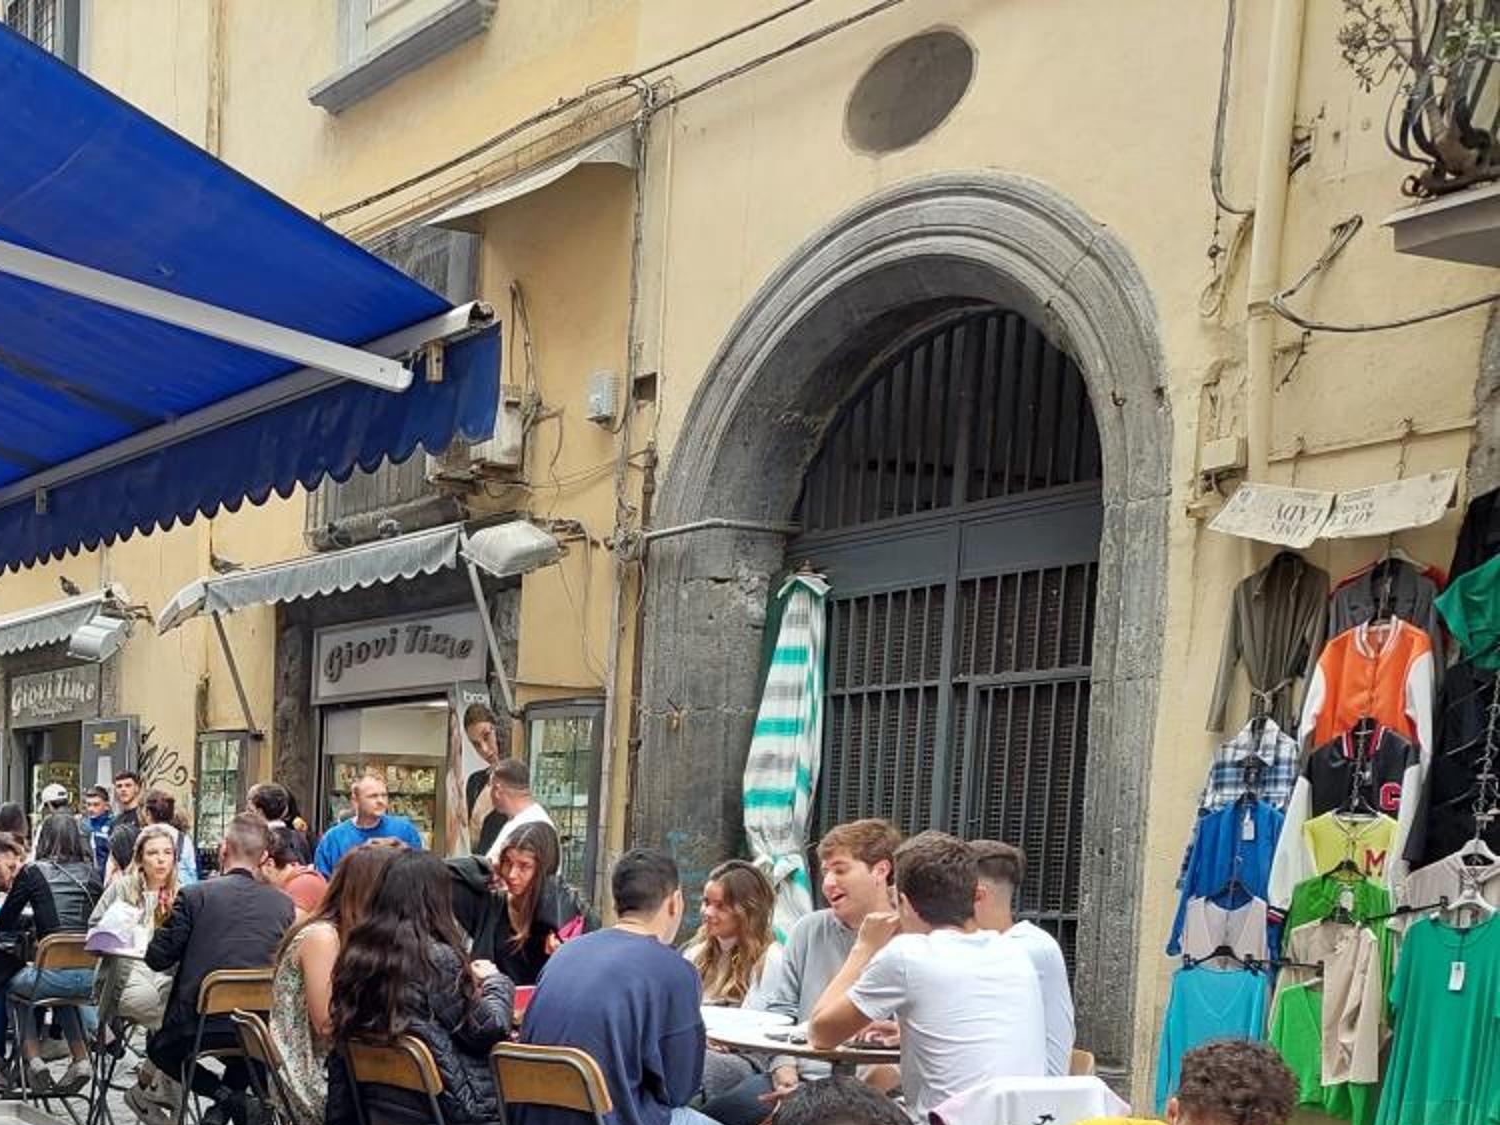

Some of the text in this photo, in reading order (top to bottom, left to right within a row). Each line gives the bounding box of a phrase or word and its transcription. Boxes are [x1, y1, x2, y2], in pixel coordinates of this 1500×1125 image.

[324, 625, 474, 683] Giovi Time
[1379, 782, 1402, 811] C
[1364, 849, 1387, 876] M
